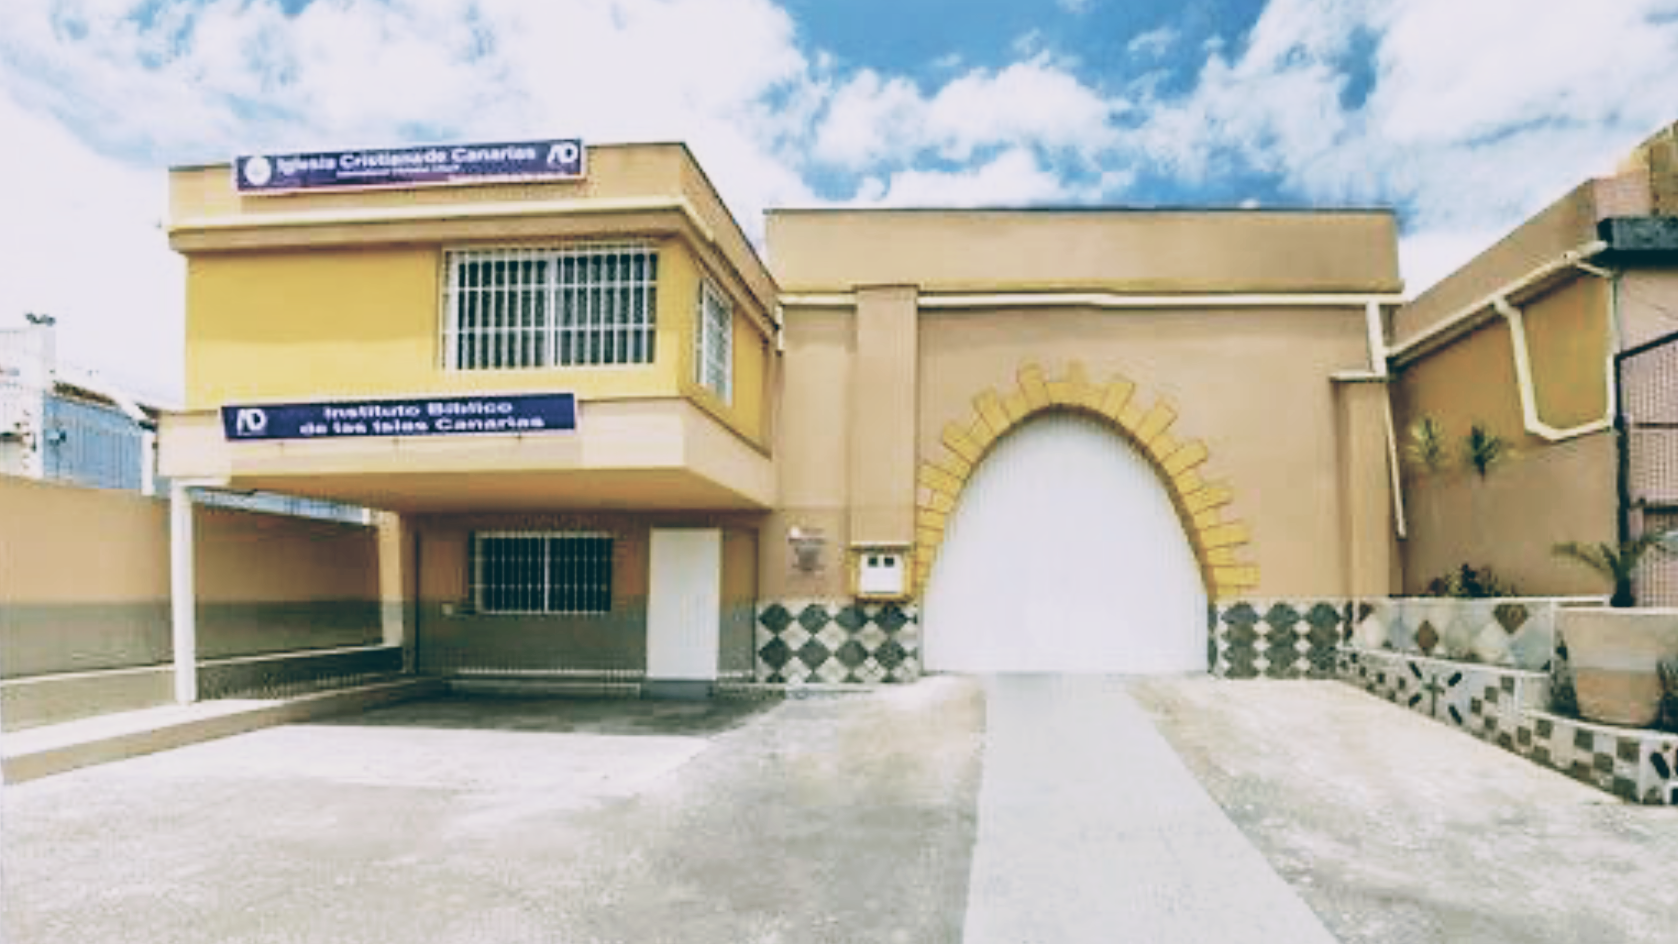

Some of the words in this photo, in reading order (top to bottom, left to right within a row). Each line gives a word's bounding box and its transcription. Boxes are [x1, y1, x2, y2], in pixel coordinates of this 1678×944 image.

[423, 148, 447, 163] de
[450, 147, 536, 163] Canarias
[323, 404, 421, 418] Instituto
[299, 422, 328, 435] de
[332, 419, 367, 434] las
[372, 417, 429, 433] Islas
[434, 416, 546, 431] Canarias
